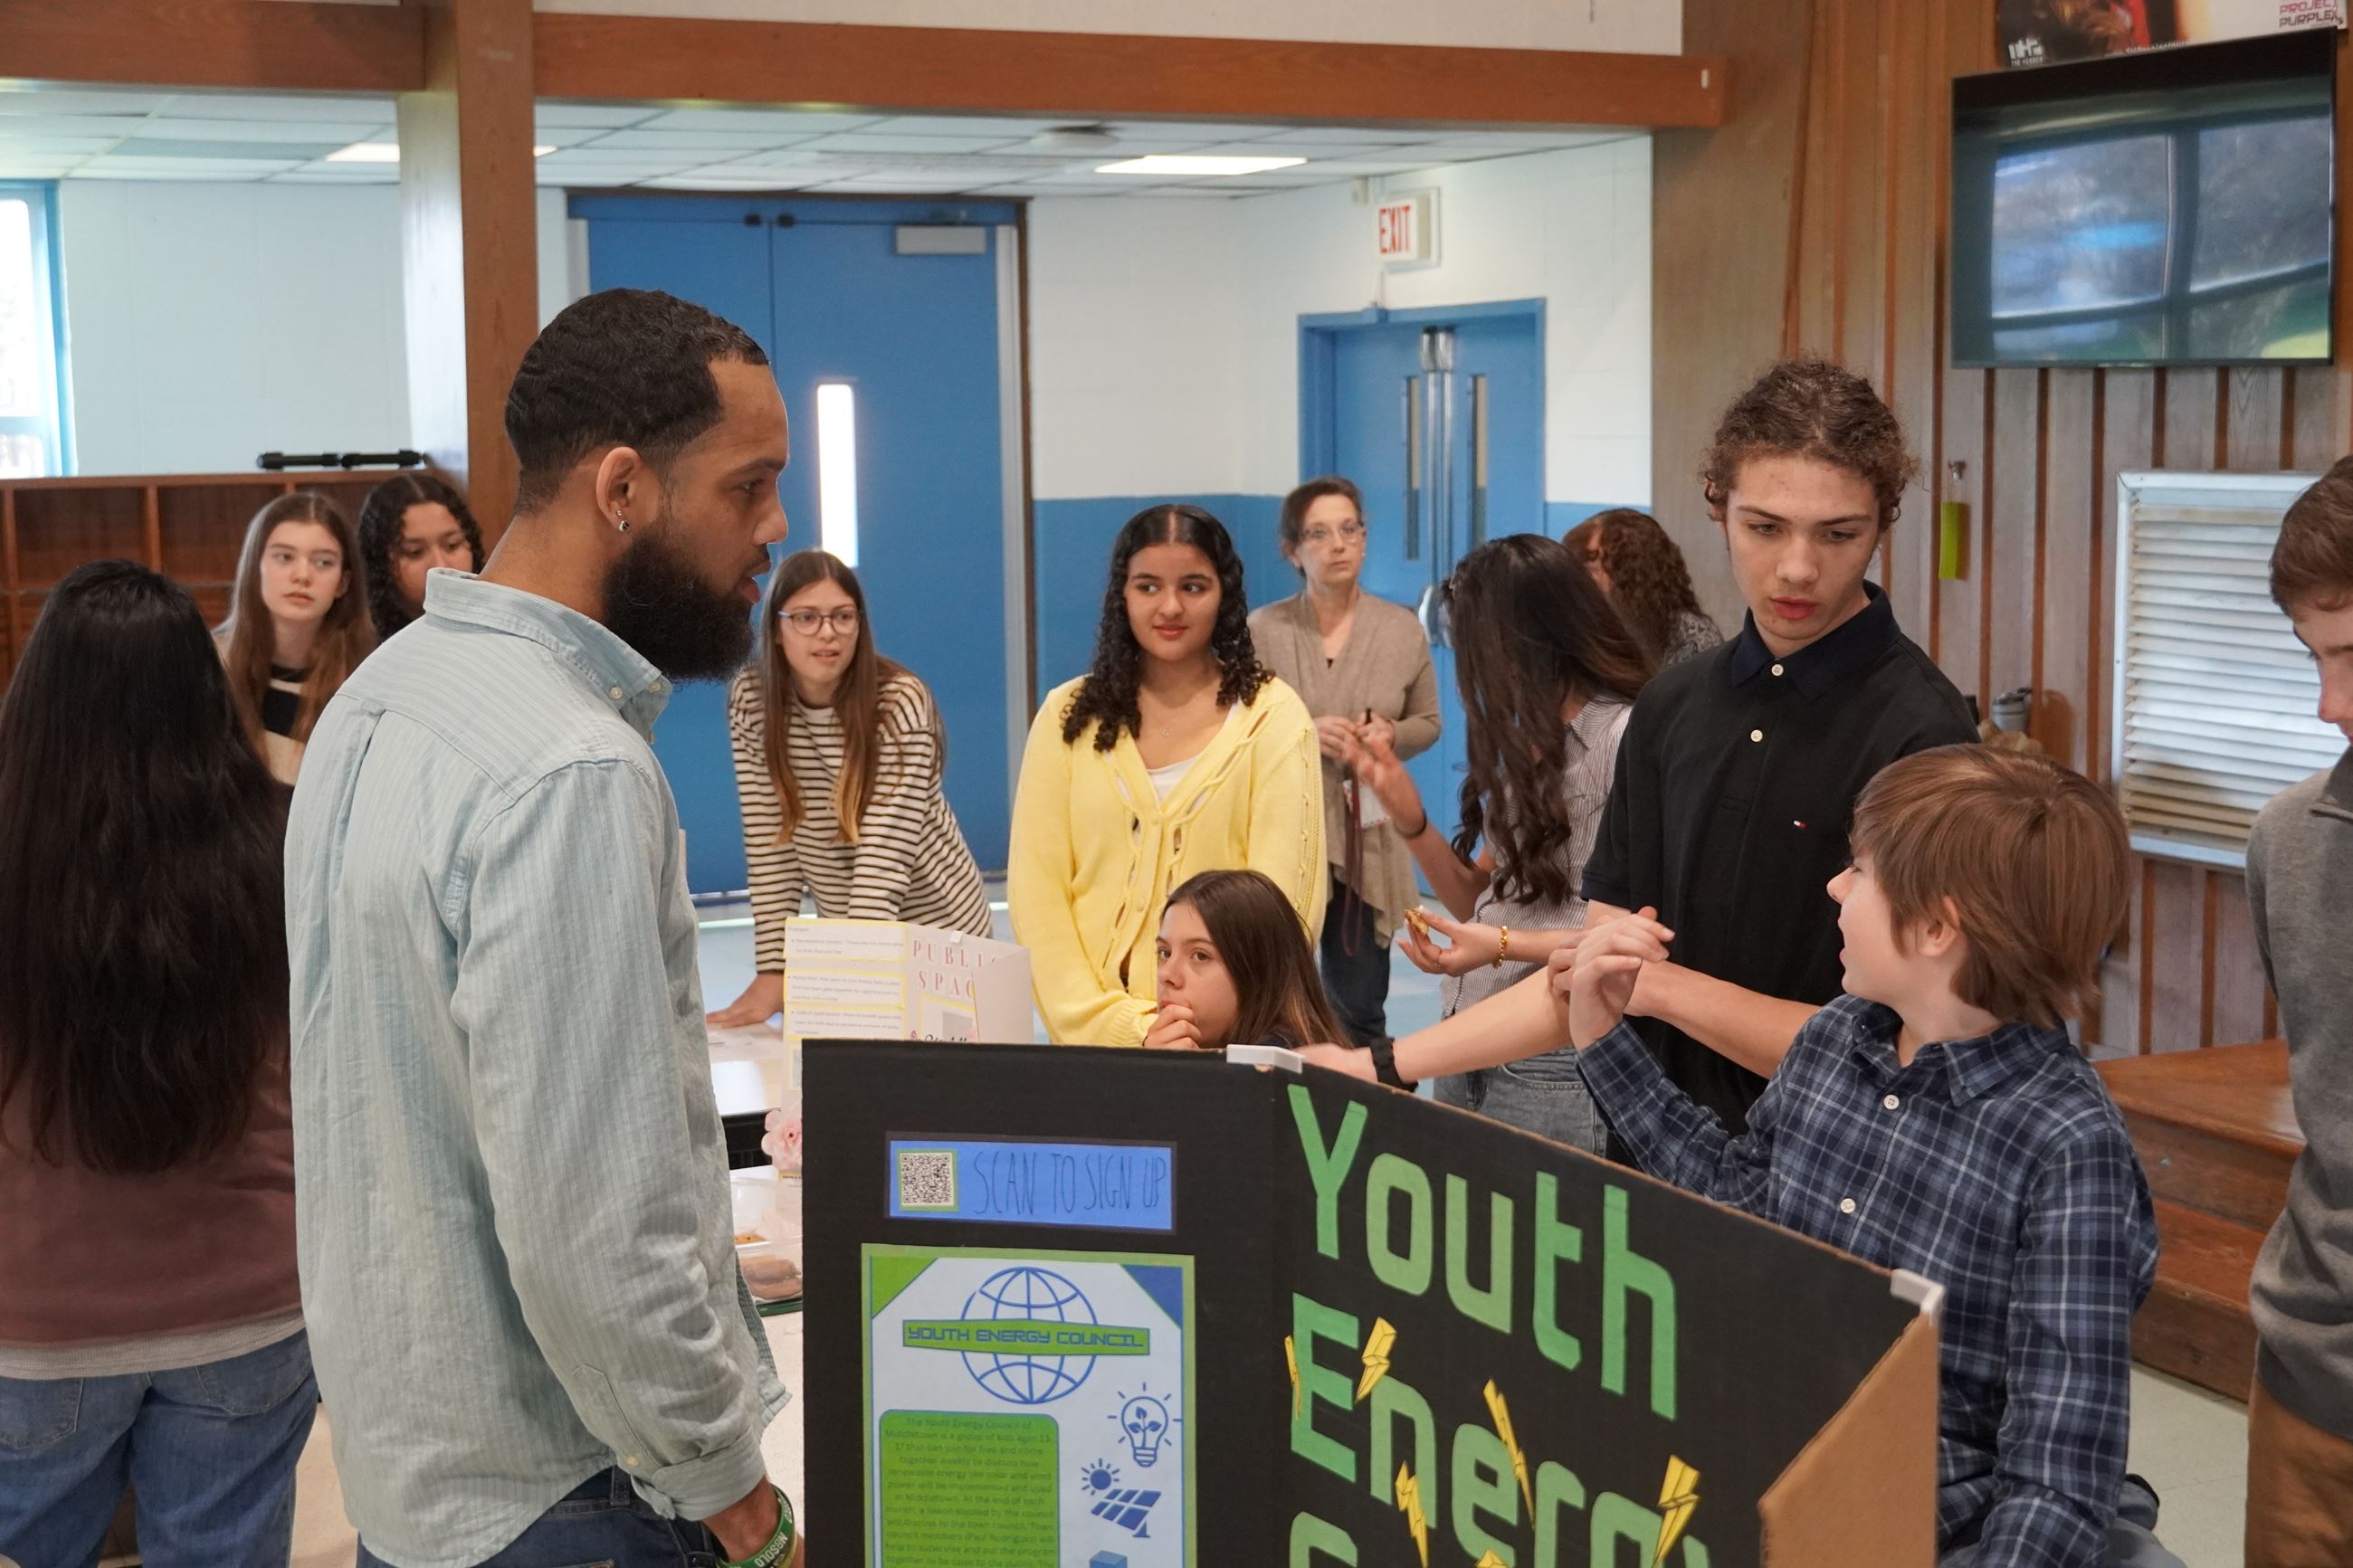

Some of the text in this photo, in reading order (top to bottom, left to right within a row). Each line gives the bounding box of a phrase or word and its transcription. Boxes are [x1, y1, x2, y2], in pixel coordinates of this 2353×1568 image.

[1378, 204, 1411, 255] EXIT
[912, 939, 996, 968] PUBLI
[973, 1151, 1167, 1215] SCAN TO SIGN UP
[1287, 1084, 1677, 1421] Youth
[908, 1326, 1144, 1348] YOUTH ENERGY COUNCIL
